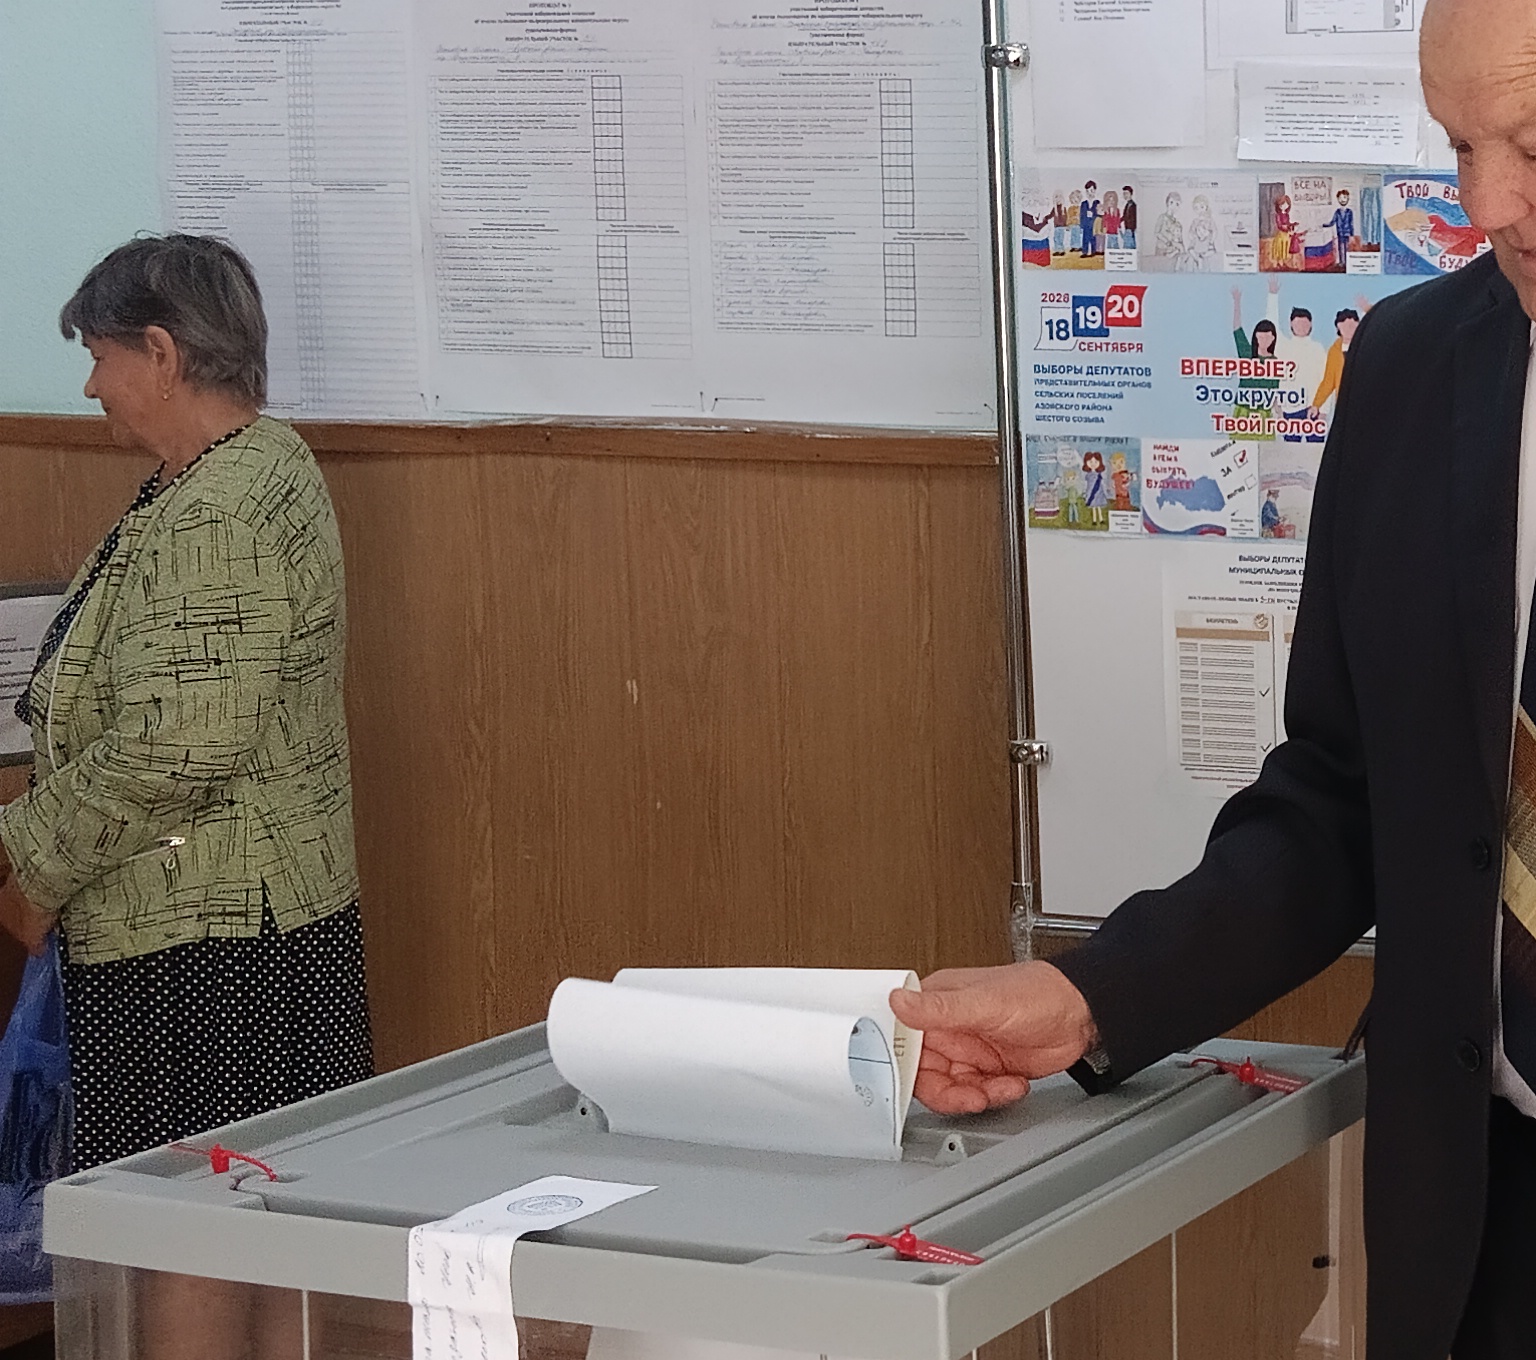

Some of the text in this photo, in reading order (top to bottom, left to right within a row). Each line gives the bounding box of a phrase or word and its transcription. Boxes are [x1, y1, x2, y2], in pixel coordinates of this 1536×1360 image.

[1395, 181, 1430, 199] ТВОЙ
[1107, 294, 1140, 319] 20
[1075, 305, 1102, 329] 19
[1045, 318, 1070, 341] 18
[1078, 341, 1144, 353] СЕНТЯБРЯ
[1033, 363, 1152, 377] ВЫБОРЫ ДЕПУТАТОВ
[1181, 358, 1296, 378] ВПЕРВЫЕ?
[1034, 390, 1124, 400] СЕЛЬСКИХ ПОСЕЛЕНИЙ
[1195, 384, 1306, 407] Это круто!
[1035, 402, 1113, 411] АЗОВСКОГО РАЙОНА
[1035, 414, 1105, 424] ШЕСТОГО СОЗЫВА
[1211, 414, 1326, 434] Твой голос
[1271, 555, 1304, 564] ДЕПУТАТ
